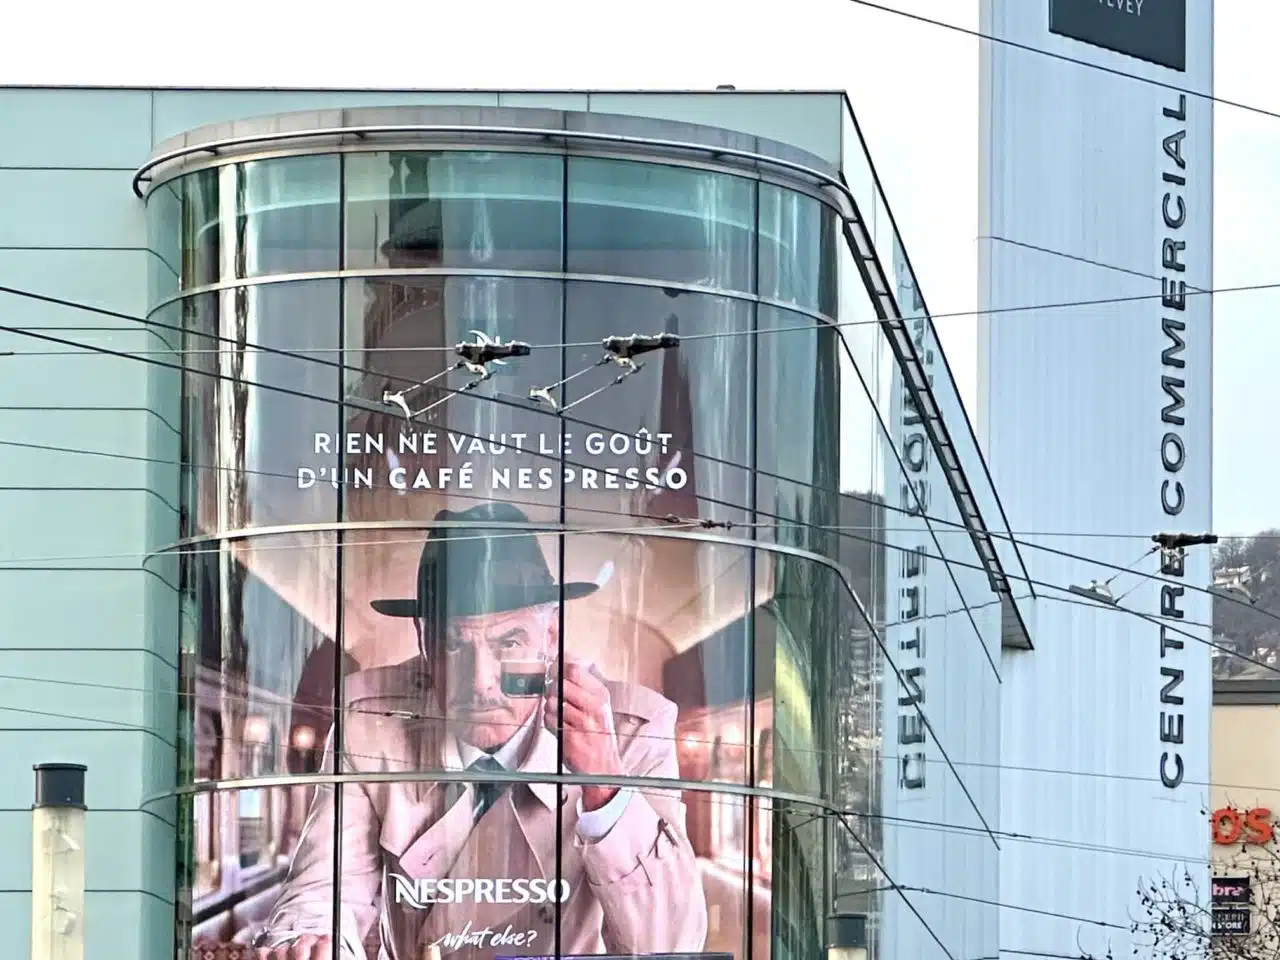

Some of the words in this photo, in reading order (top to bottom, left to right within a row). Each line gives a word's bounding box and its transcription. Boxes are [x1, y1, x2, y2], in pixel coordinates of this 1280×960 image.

[1098, 0, 1144, 16] VEY
[1160, 94, 1187, 516] COMMERCIAL
[314, 432, 384, 454] RIEN
[400, 432, 437, 454] NE
[447, 432, 527, 455] VAUT
[539, 433, 572, 454] LE
[585, 427, 673, 455] GOÛT
[297, 467, 373, 489] D'UN
[388, 461, 473, 490] CAFÉ
[492, 467, 688, 490] NESPRESSO
[1160, 545, 1185, 789] CENTRE
[389, 873, 571, 909] NESPRESSO
[430, 920, 494, 950] what
[490, 924, 538, 948] else?
